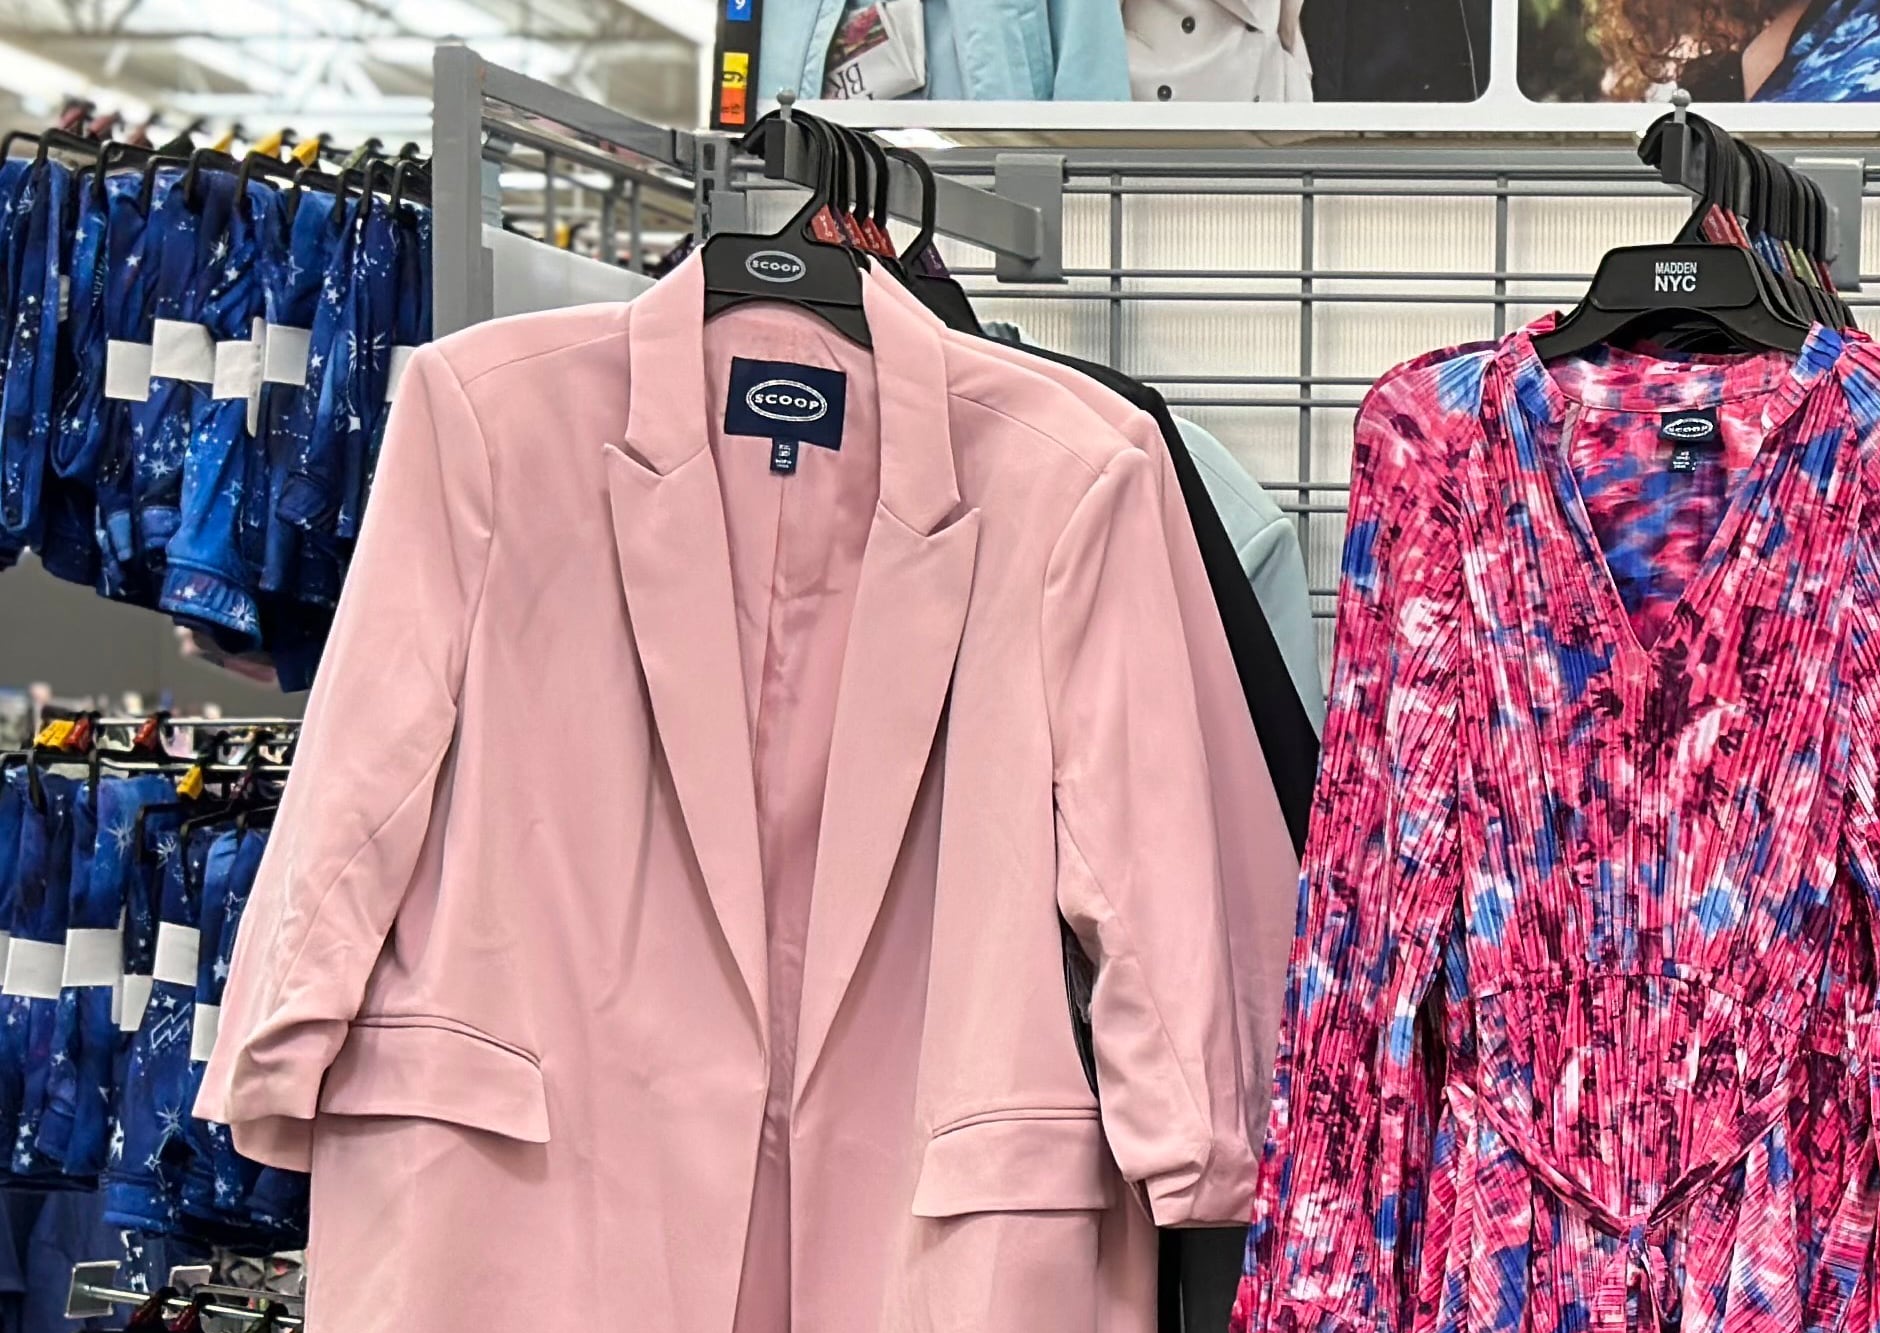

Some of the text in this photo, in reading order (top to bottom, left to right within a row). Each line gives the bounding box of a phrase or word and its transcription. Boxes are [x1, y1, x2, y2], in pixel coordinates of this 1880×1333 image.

[752, 259, 800, 273] SCOOP
[1655, 261, 1697, 275] MADDEN
[1655, 275, 1697, 292] NYC
[755, 393, 820, 411] SCOOP
